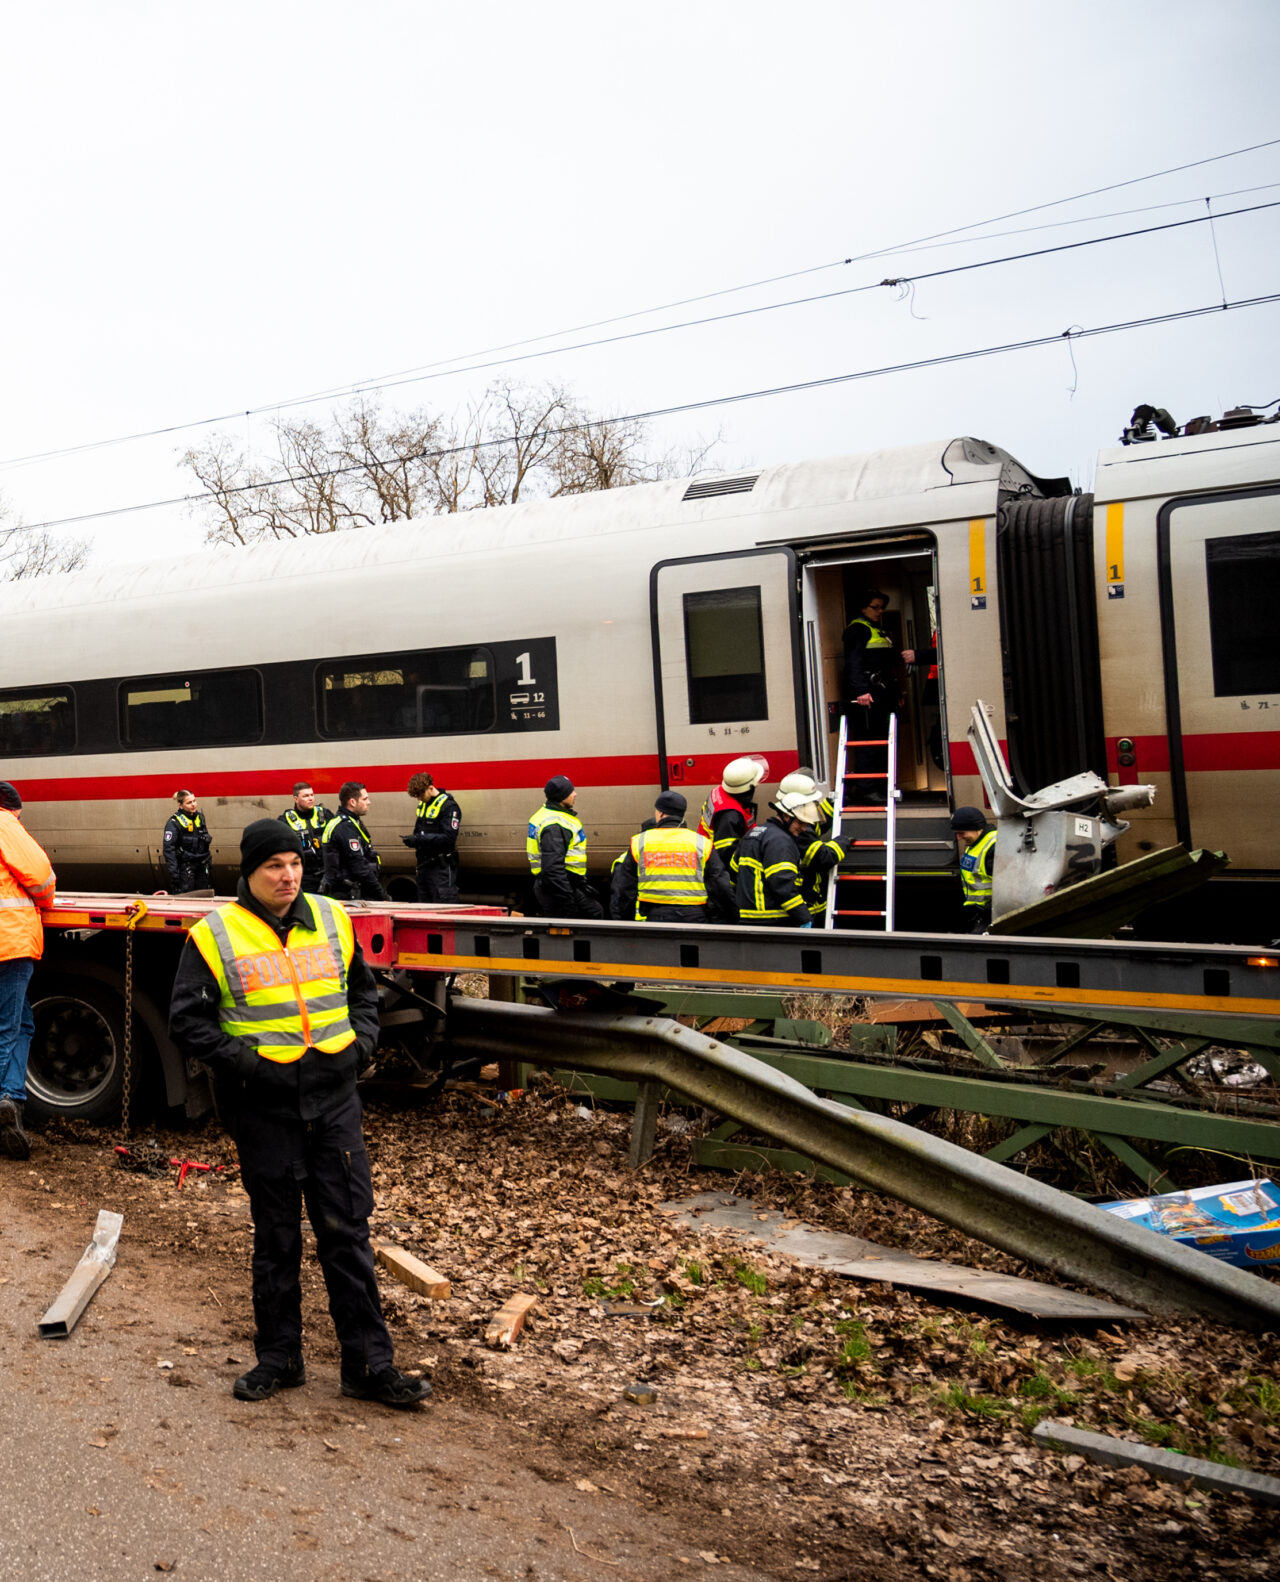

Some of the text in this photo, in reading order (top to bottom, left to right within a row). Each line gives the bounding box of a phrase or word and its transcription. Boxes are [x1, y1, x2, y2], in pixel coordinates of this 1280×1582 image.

[1109, 564, 1121, 580] 1
[972, 577, 983, 592] 1
[515, 652, 536, 686] 1
[533, 692, 545, 702] 12
[1257, 701, 1269, 710] 71
[1079, 823, 1089, 832] H2
[646, 851, 697, 868] POLIZEI
[237, 947, 339, 991] POLIZEI
